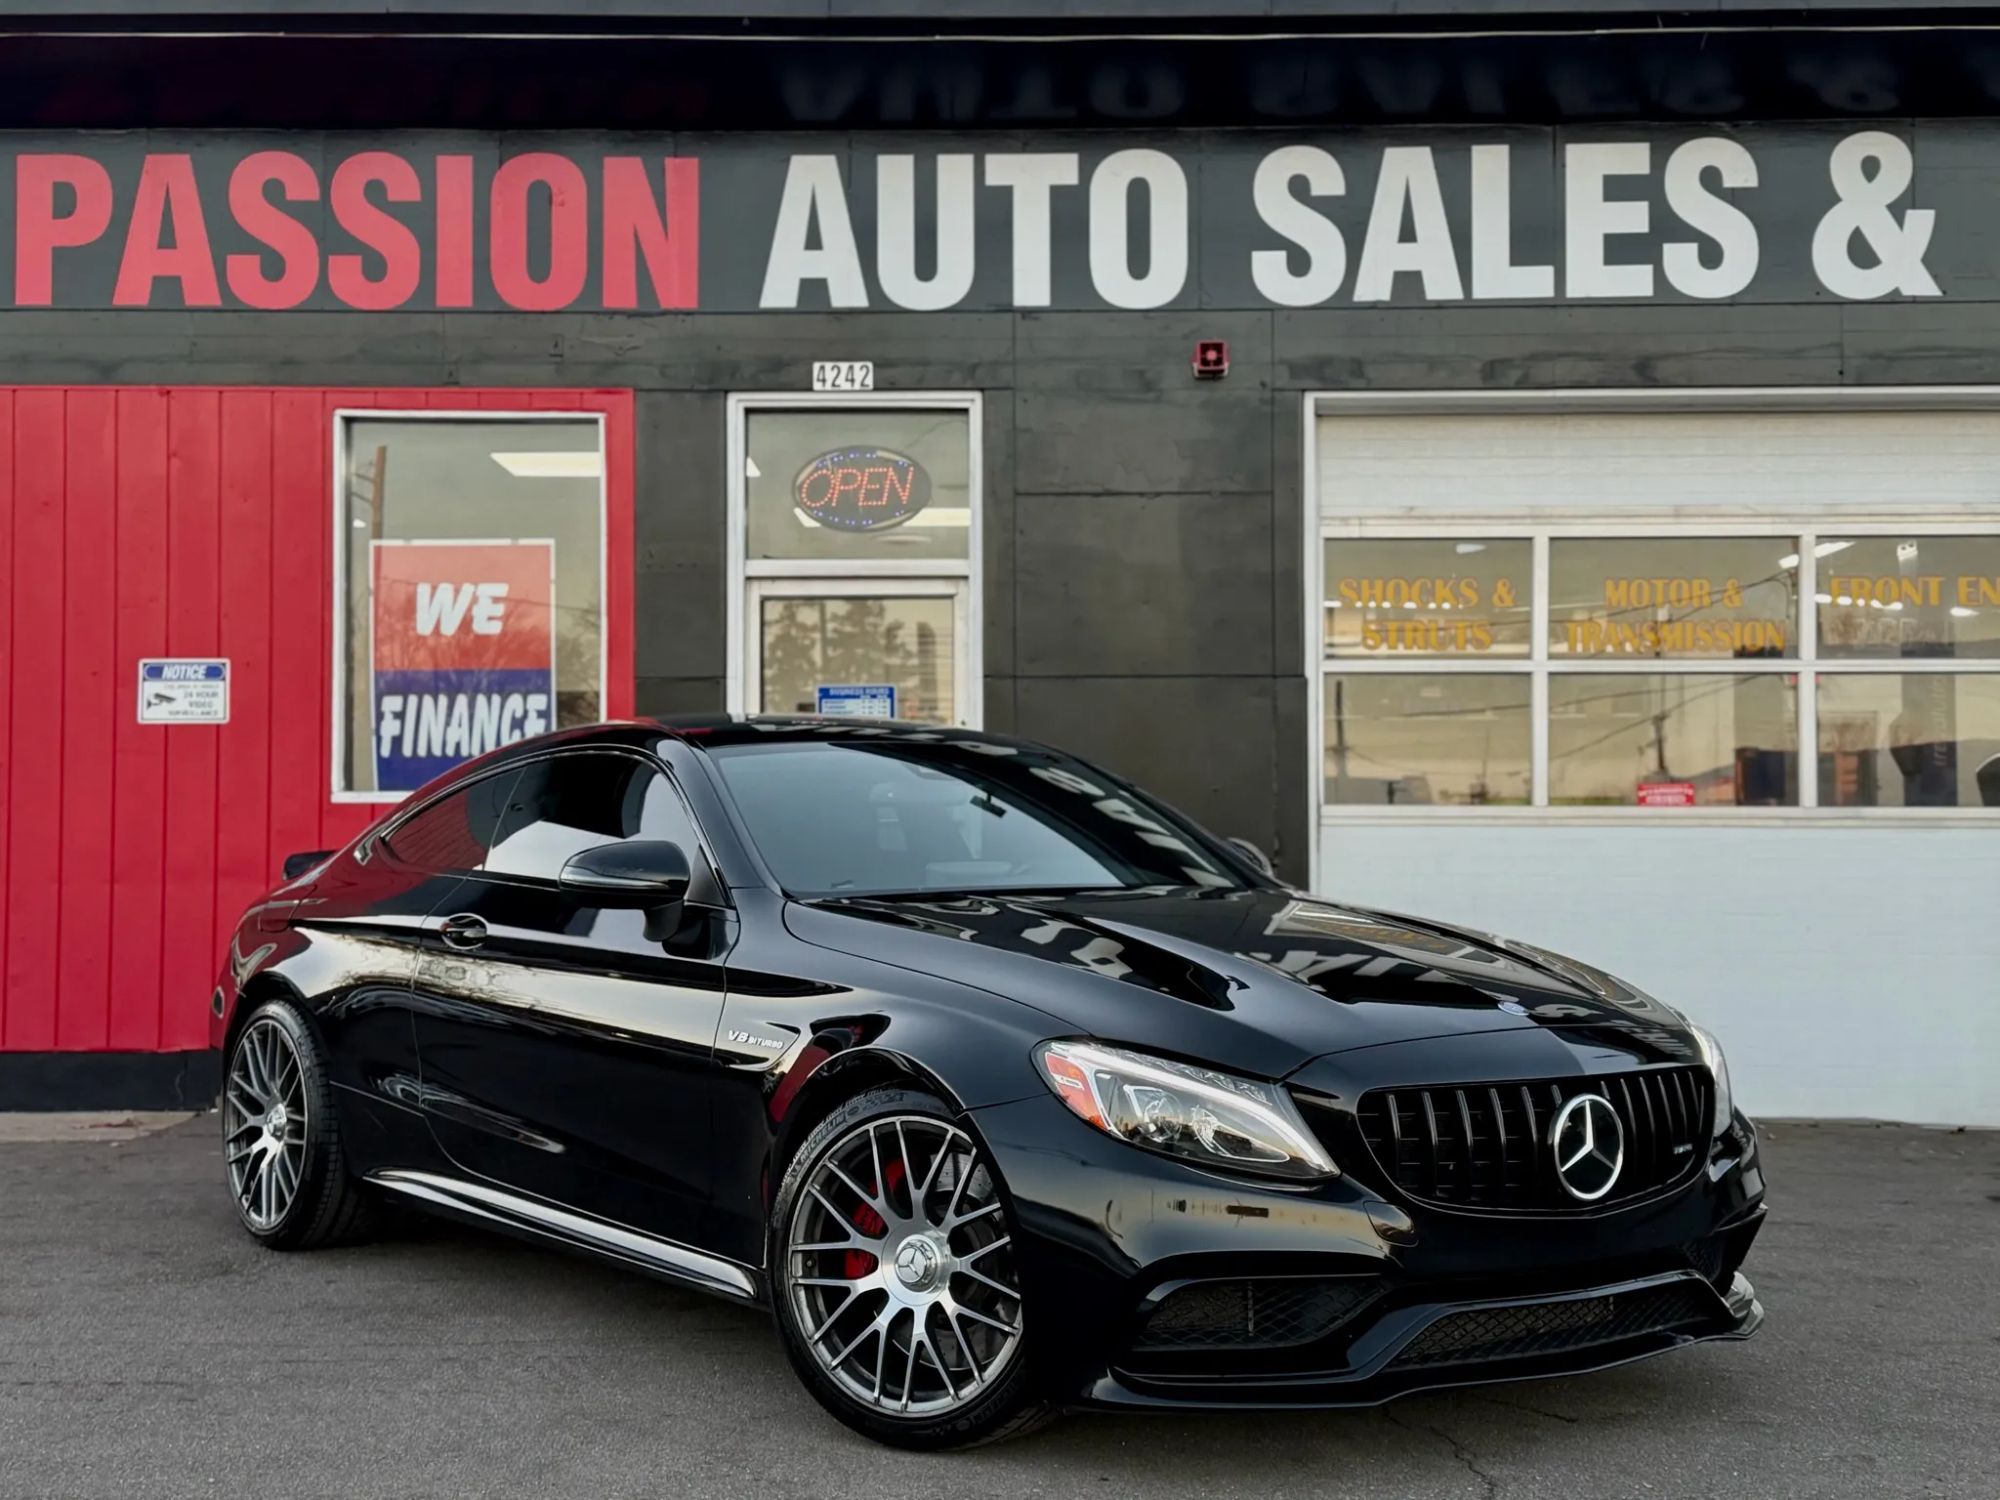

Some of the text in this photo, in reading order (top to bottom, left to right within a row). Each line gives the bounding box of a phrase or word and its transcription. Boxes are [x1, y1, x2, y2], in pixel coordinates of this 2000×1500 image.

[15, 131, 1944, 311] PASSION AUTO SALES &
[816, 364, 872, 388] 4242
[801, 465, 915, 508] OPEN
[1339, 577, 1517, 608] SHOCKS &
[1604, 577, 1745, 608] MOTOR &
[1830, 575, 1945, 607] FRONT
[416, 582, 510, 636] WE
[1362, 619, 1494, 651] STRUTS
[1566, 620, 1787, 652] TRANSMISSION
[162, 664, 207, 679] NOTICE
[380, 693, 548, 759] FINANCE
[728, 1029, 784, 1049] V8 BITURBO
[800, 1111, 848, 1162] MICHELIN
